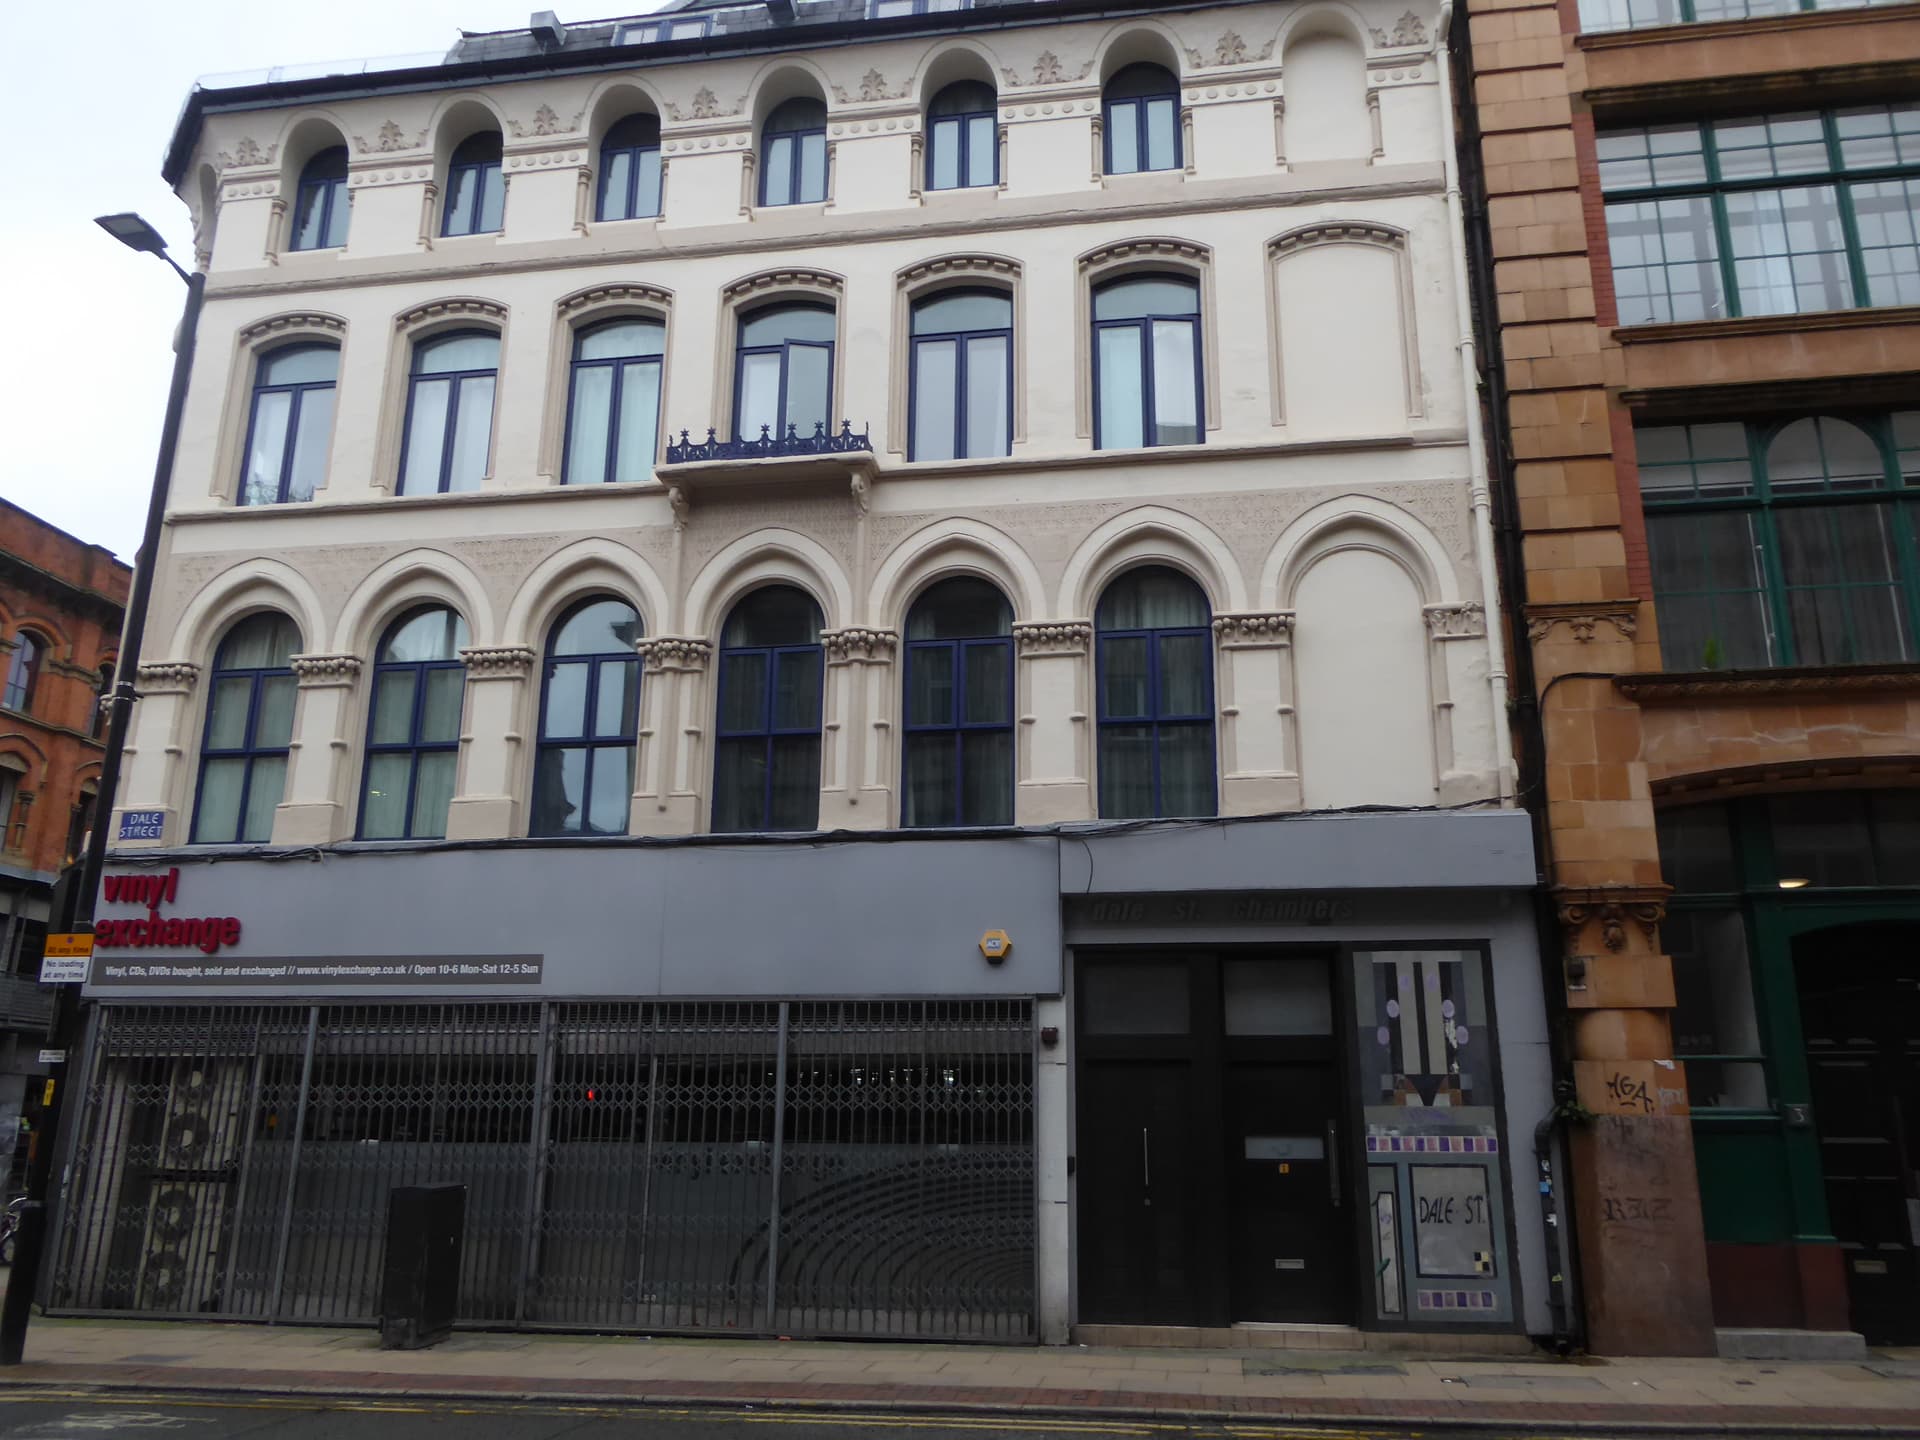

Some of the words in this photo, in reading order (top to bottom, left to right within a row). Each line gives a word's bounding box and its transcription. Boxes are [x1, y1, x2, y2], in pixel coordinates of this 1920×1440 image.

[130, 813, 160, 825] DALE
[119, 825, 163, 838] STREET
[104, 867, 180, 910] vinyl
[95, 911, 242, 954] exchange
[46, 960, 56, 968] No
[58, 960, 85, 969] loading
[105, 965, 127, 978] Vinyl,
[129, 965, 147, 978] CDs,
[172, 965, 202, 978] bought,
[204, 965, 221, 976] sold
[223, 965, 239, 976] and
[240, 964, 286, 978] exchanged
[297, 964, 406, 977] www.vinylexchange.co.uk
[414, 965, 437, 976] Open
[439, 964, 458, 975] 10-6
[460, 964, 498, 975] Mon-Sat
[500, 964, 520, 974] 12-5
[521, 963, 539, 974] Sun
[53, 972, 66, 980] any
[1792, 1107, 1805, 1122] 3
[1418, 1196, 1455, 1225] DALE
